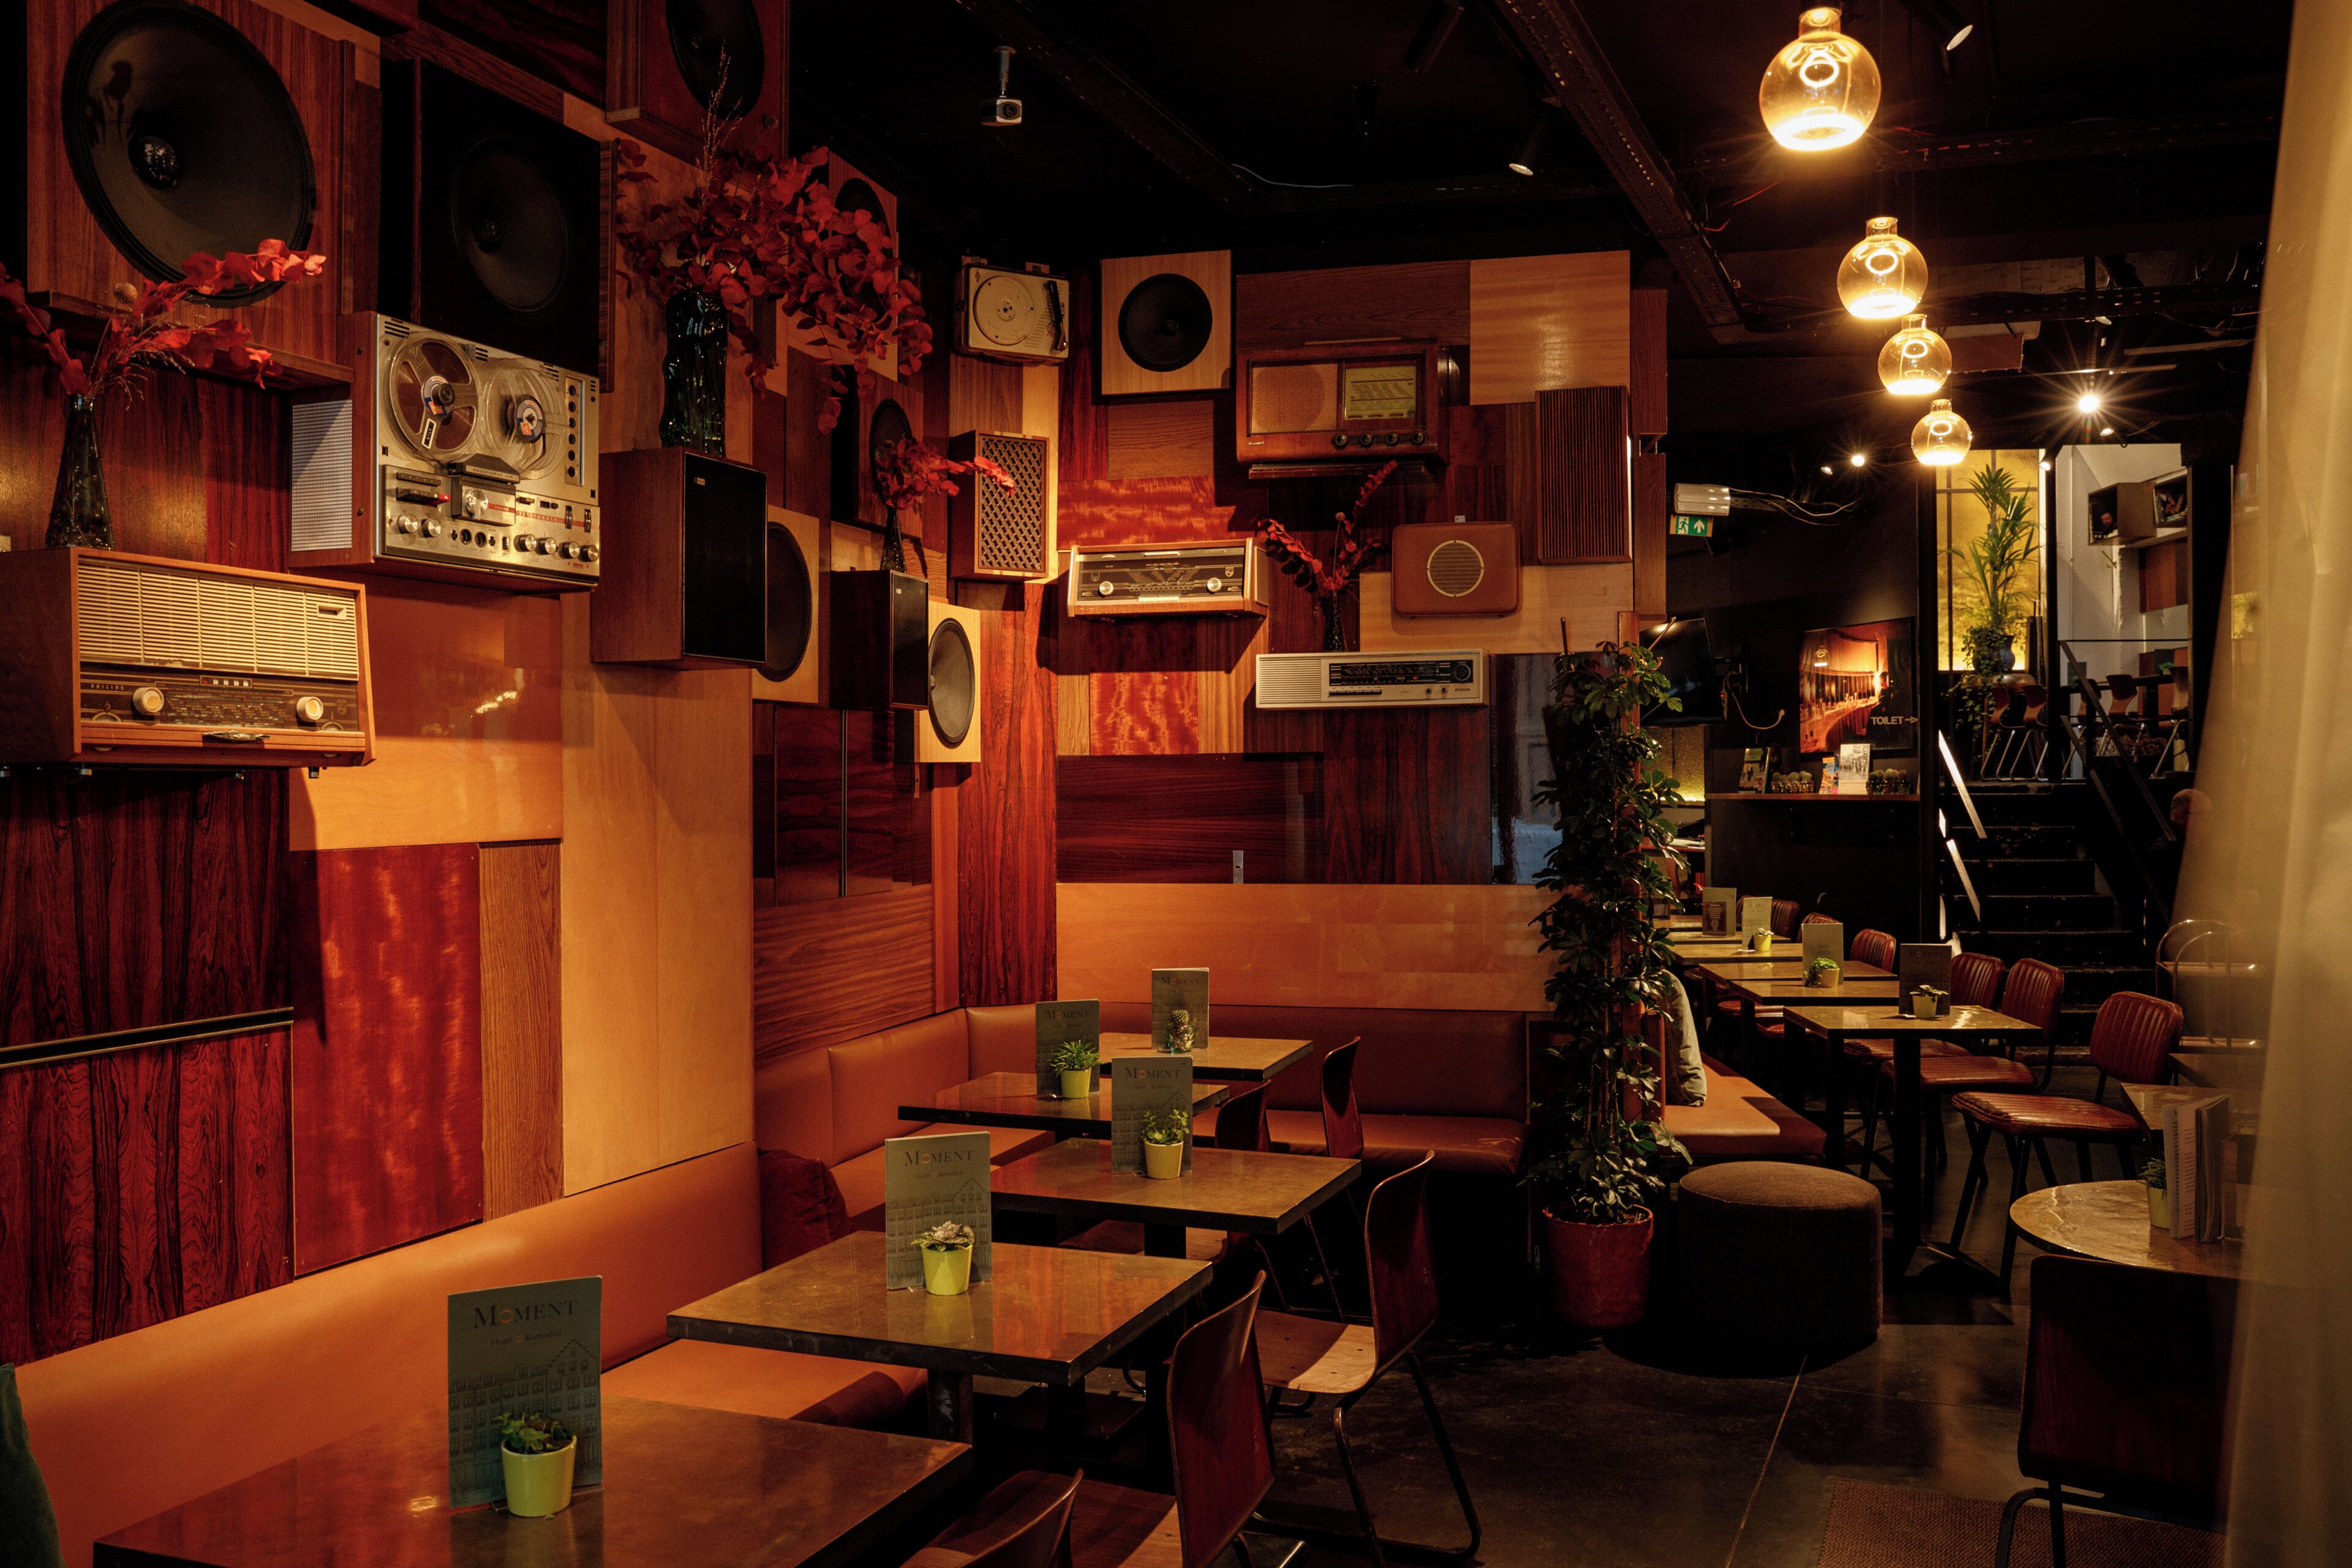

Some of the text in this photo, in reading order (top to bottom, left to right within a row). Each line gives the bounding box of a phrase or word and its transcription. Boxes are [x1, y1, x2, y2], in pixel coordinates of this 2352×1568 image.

[519, 511, 558, 522] TELEFUNKEN
[1871, 716, 1904, 725] TOILET
[491, 1337, 512, 1346] Hotel
[524, 1330, 562, 1341] Kathedral
